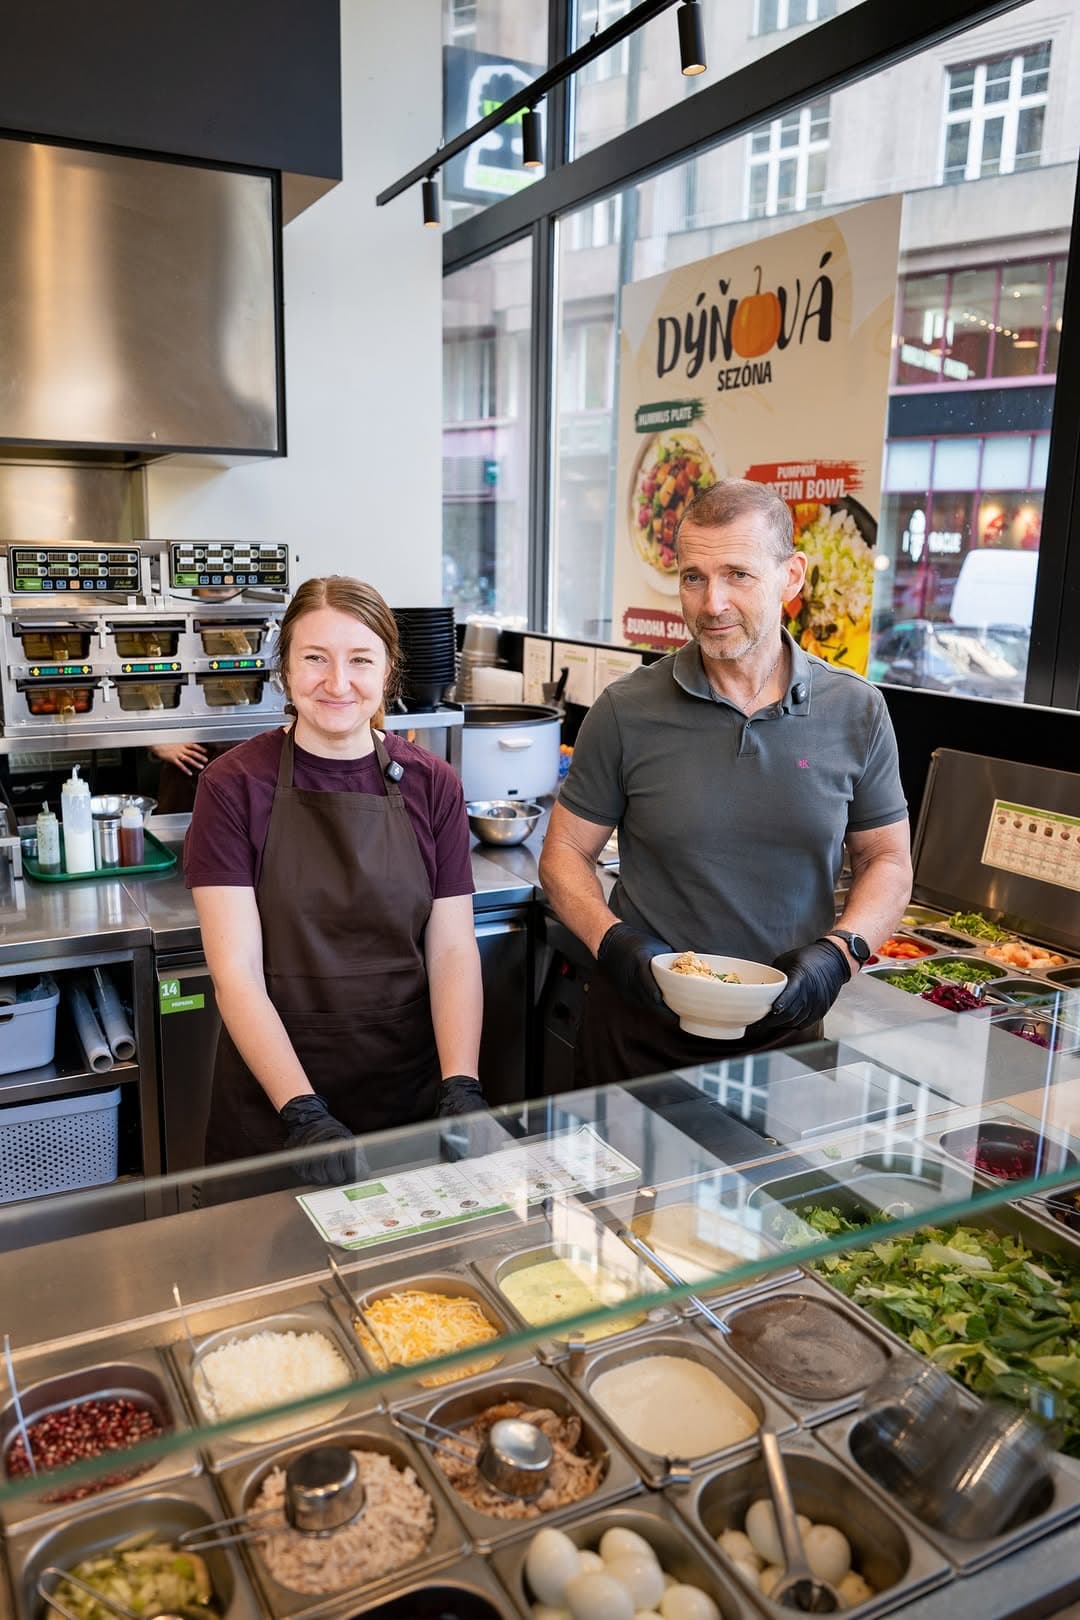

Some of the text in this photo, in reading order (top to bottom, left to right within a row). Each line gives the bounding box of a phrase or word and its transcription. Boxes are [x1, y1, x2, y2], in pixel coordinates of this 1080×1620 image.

[717, 360, 772, 391] SEZÓNA
[671, 406, 692, 422] PLATE
[777, 464, 817, 479] PUMPKIN
[806, 478, 847, 499] BOWL
[627, 617, 694, 641] BUDDHA SALA
[161, 982, 178, 997] 14
